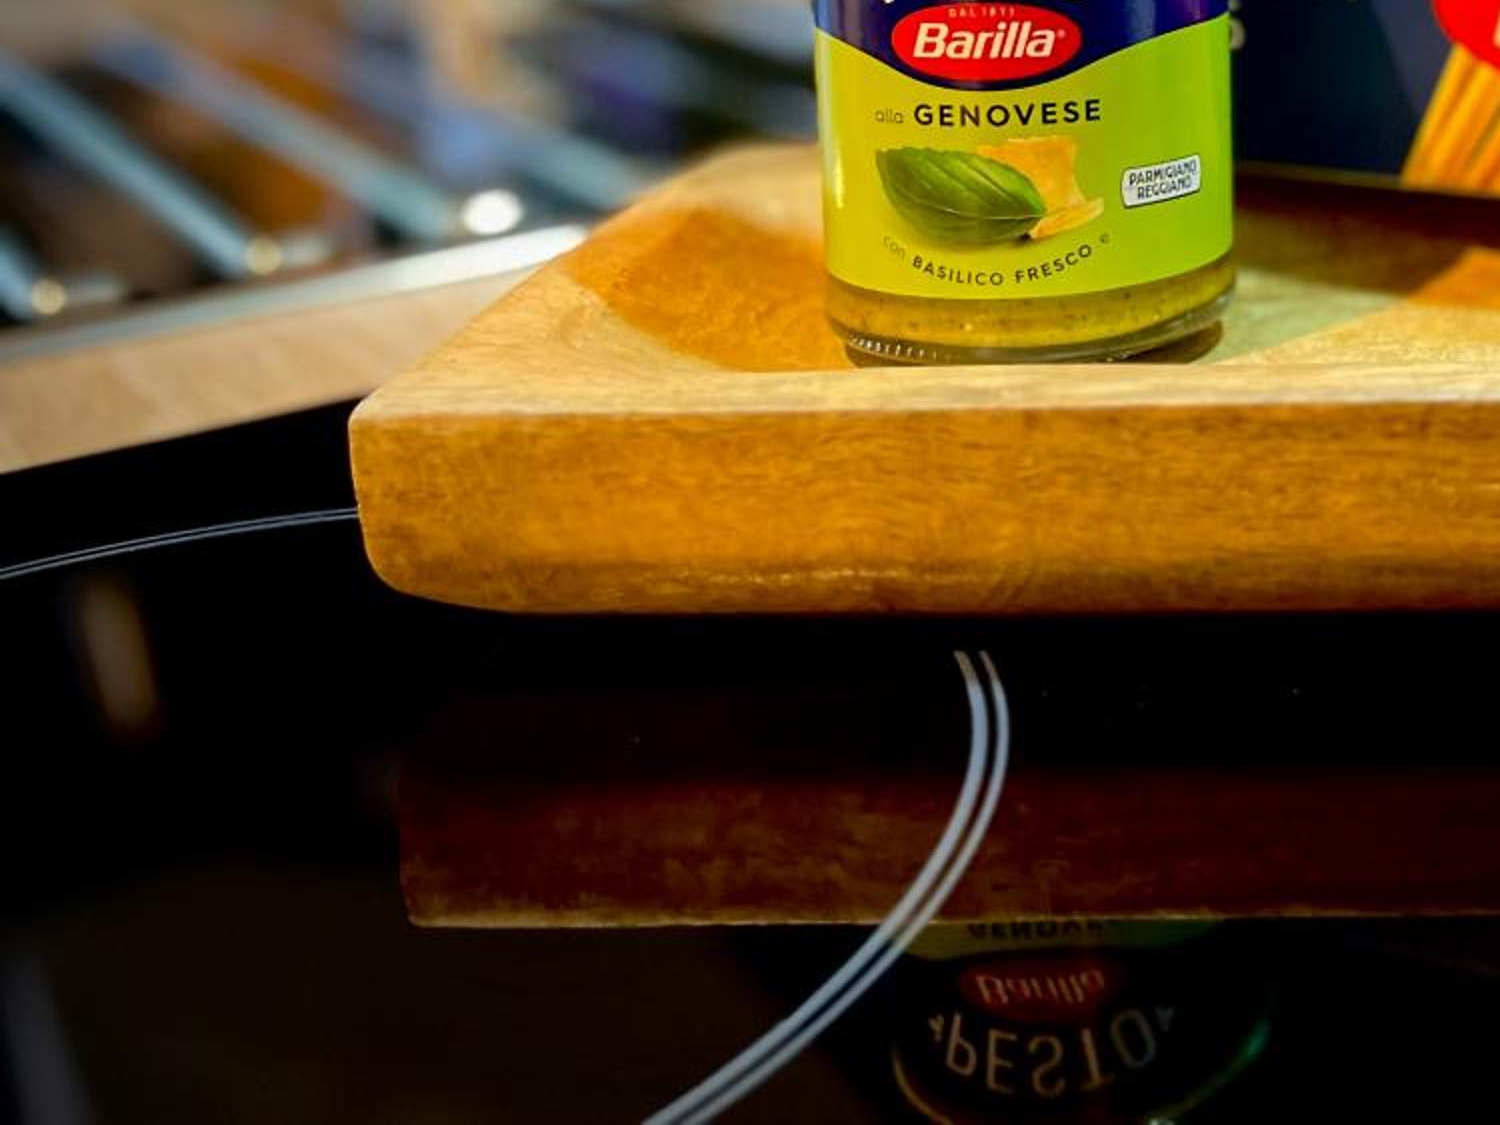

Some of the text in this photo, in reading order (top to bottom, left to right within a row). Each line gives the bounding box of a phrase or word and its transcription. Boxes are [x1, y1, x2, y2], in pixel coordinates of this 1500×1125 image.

[875, 98, 1102, 127] alla GENOVESE
[1129, 158, 1198, 186] PARMIGIANO
[1137, 174, 1192, 200] REGGIANO
[883, 235, 906, 261] con
[911, 254, 1005, 287] BASILICO
[1015, 244, 1092, 284] FRESCO
